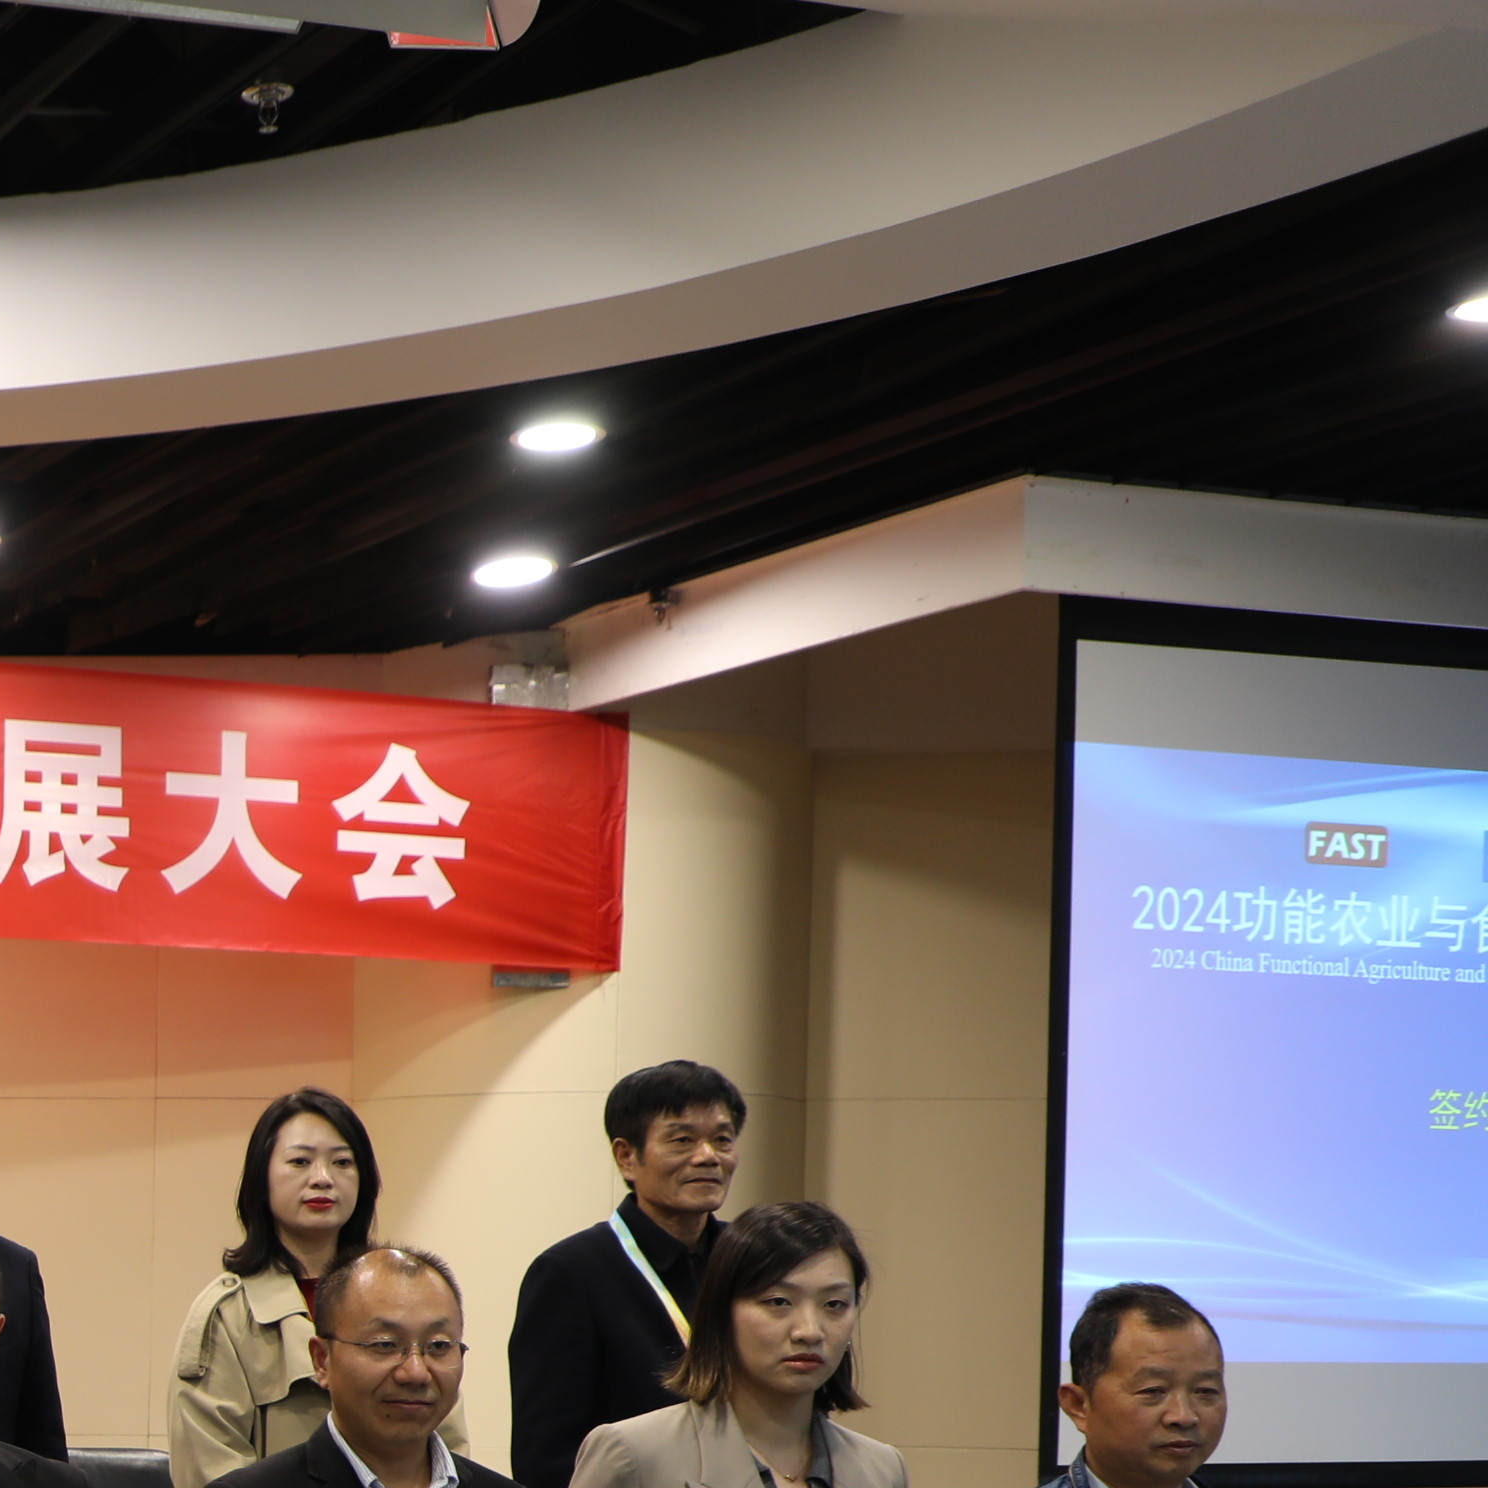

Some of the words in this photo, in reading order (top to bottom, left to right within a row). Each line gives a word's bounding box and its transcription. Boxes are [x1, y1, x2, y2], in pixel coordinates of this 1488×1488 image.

[1308, 830, 1387, 861] FAST
[1150, 946, 1196, 970] 2024
[1200, 948, 1254, 973] China
[1259, 952, 1350, 978] Functional
[1353, 957, 1451, 985] Agriculture
[1455, 963, 1485, 983] and
